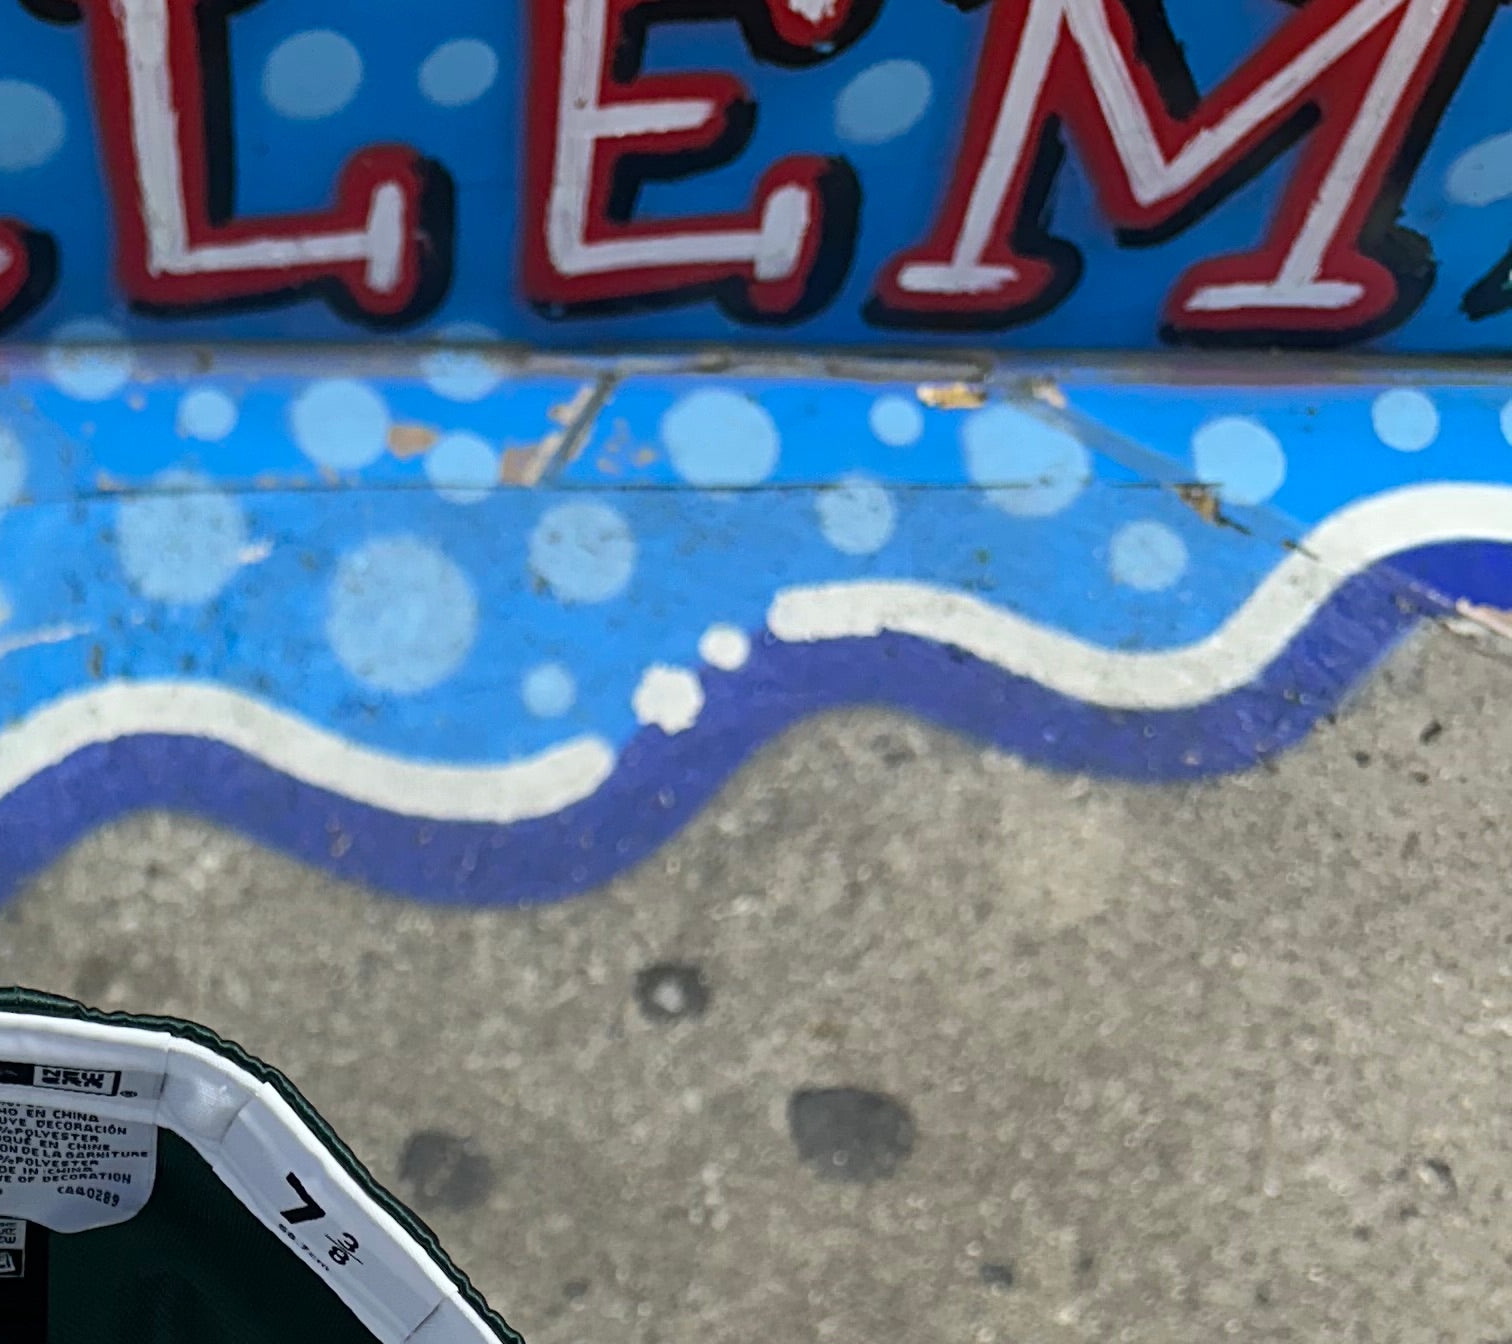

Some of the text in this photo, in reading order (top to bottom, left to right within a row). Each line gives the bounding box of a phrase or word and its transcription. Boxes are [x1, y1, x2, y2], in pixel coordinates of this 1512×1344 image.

[26, 1109, 46, 1118] EN
[53, 1110, 99, 1122] CHINA
[40, 1139, 59, 1149] EN
[23, 1167, 38, 1175] IN
[17, 1175, 35, 1183] OF
[42, 1172, 131, 1184] DECORATION
[280, 1171, 326, 1224] 7
